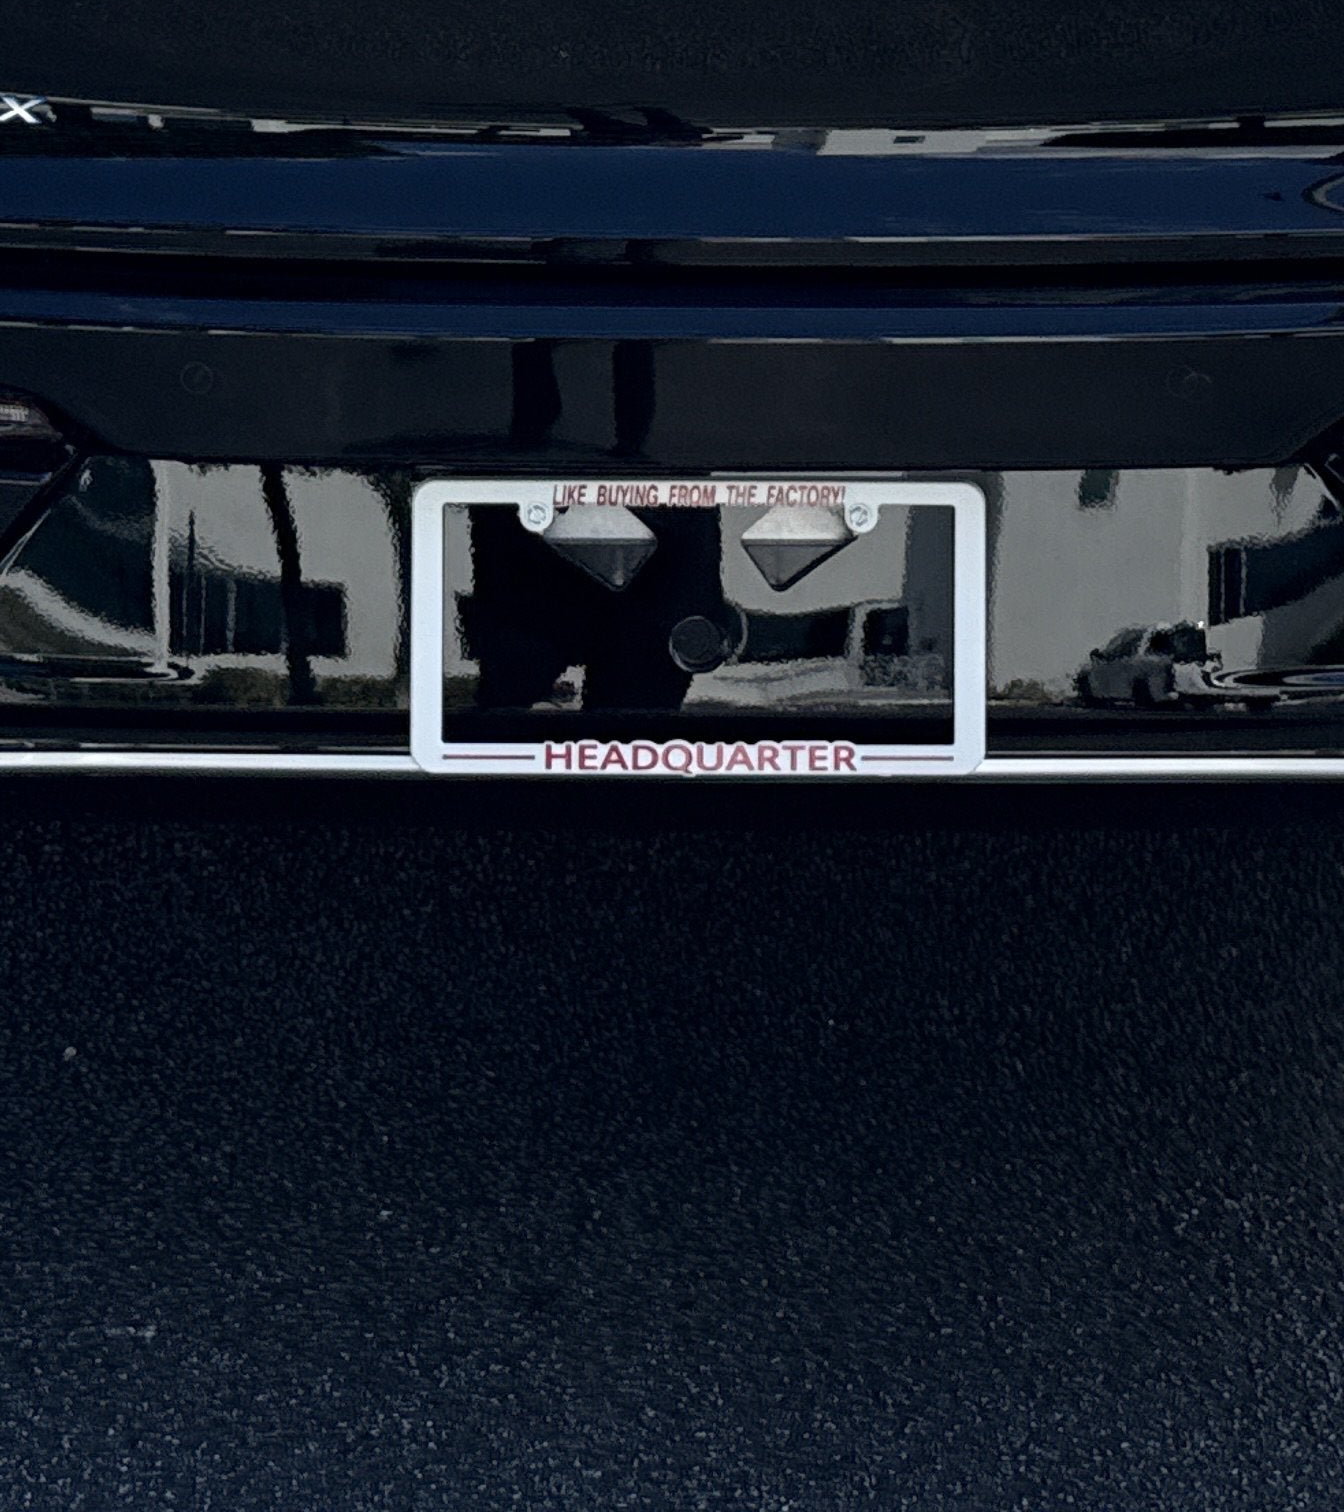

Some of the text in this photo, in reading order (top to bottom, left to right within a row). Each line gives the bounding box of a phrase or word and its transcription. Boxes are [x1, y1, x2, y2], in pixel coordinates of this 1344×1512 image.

[552, 483, 846, 507] LIKE BUYING FROM THE FACTORY!
[544, 744, 857, 773] HEADQUARTER
